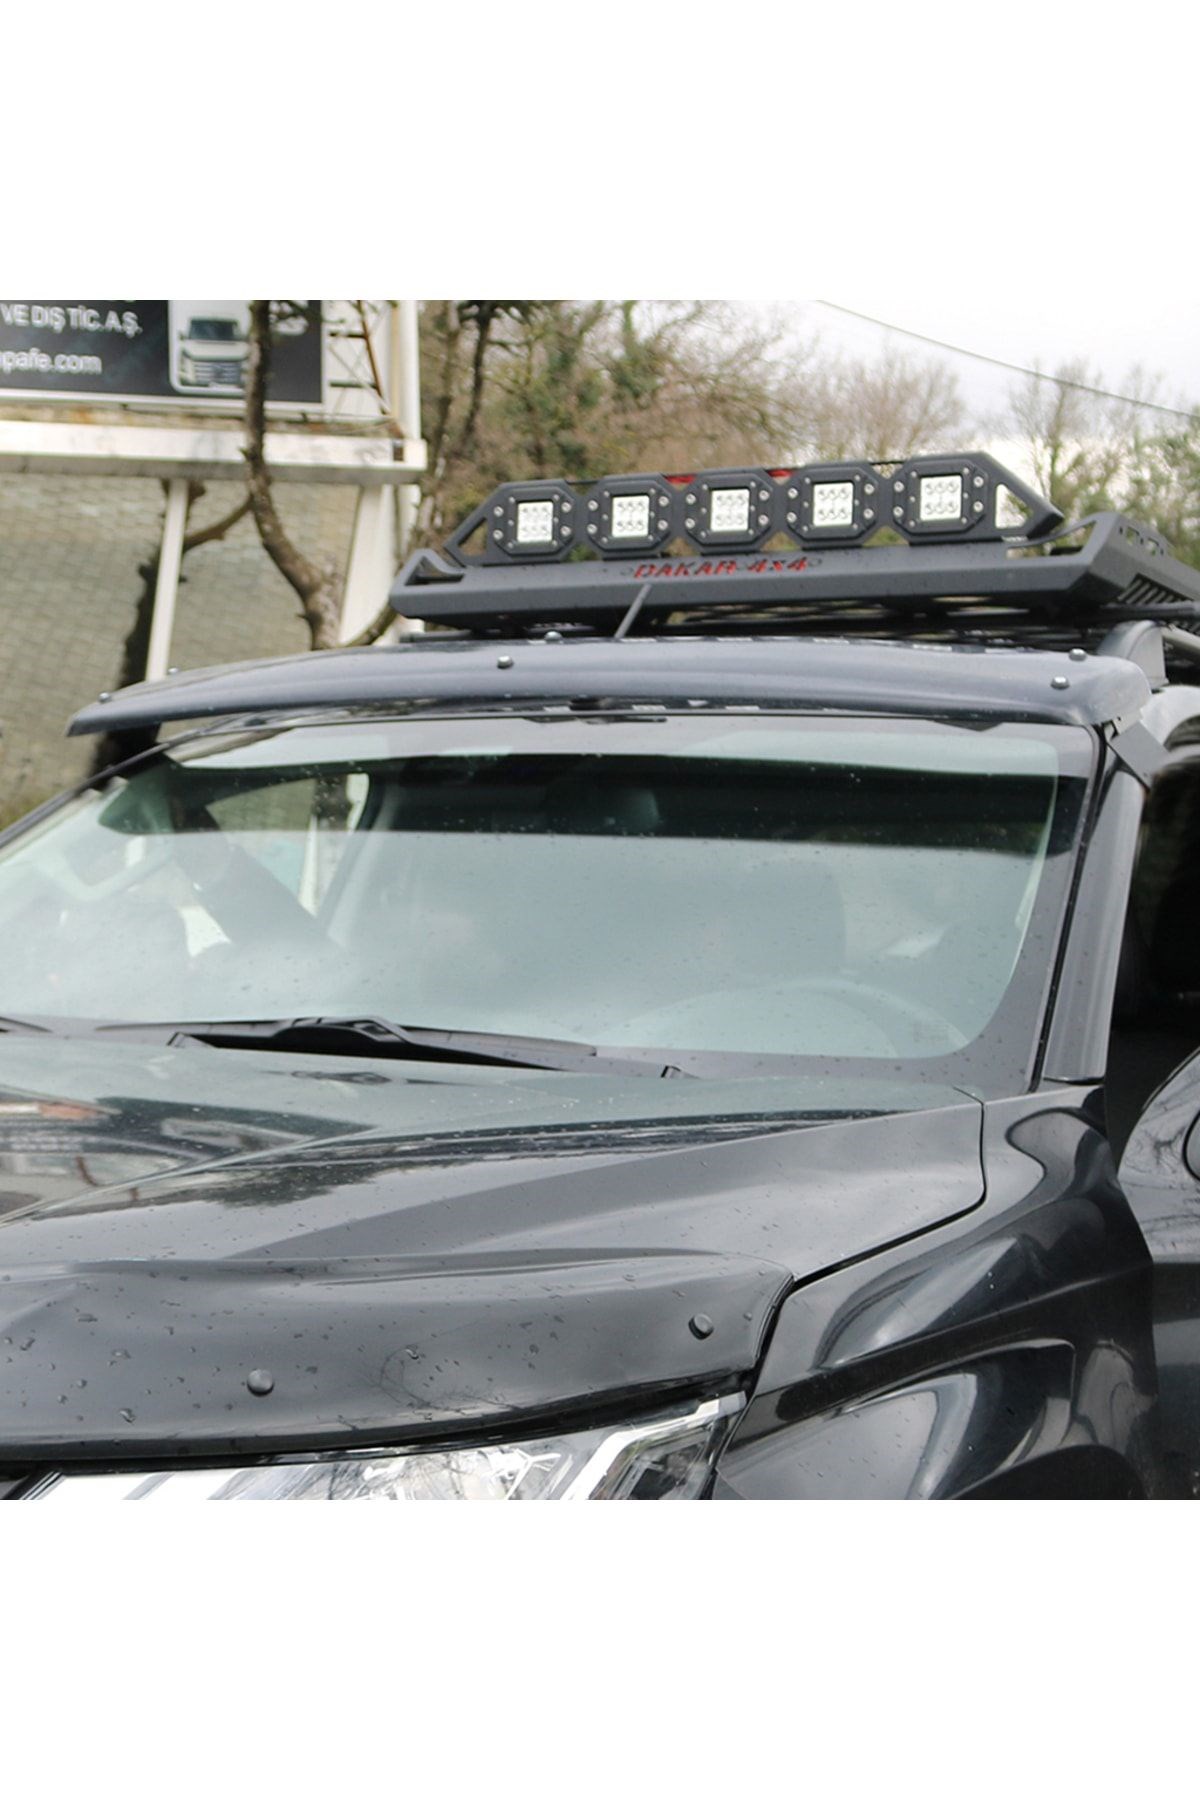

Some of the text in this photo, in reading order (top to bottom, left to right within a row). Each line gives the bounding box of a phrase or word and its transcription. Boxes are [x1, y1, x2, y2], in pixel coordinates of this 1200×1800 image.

[31, 306, 65, 332] DIŞ
[0, 347, 102, 374] pafe.com
[633, 556, 808, 578] DAKAR 4x4
